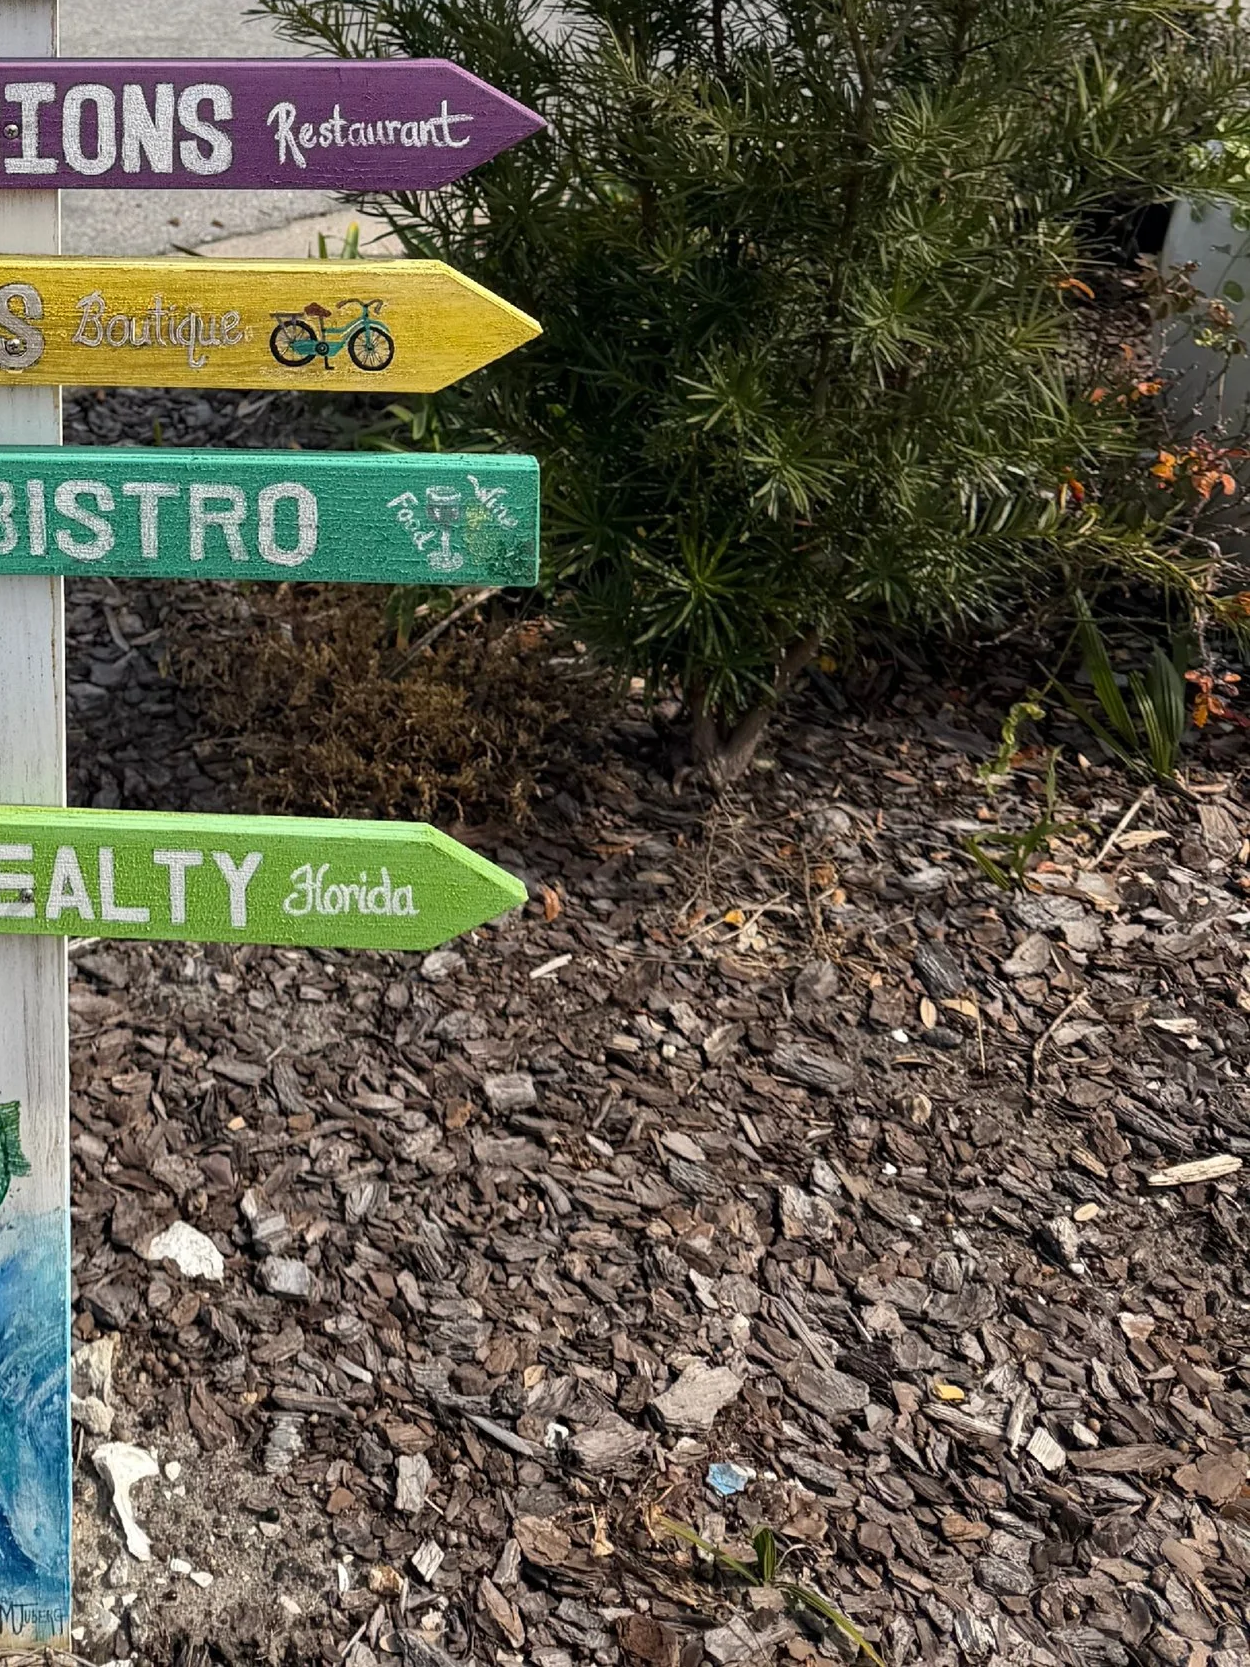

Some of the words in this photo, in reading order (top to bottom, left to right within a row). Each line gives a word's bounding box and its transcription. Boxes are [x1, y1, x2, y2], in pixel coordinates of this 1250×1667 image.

[266, 100, 474, 168] Restaurant
[71, 291, 244, 369] Boutique
[386, 491, 437, 551] Food
[282, 862, 420, 917] Florida
